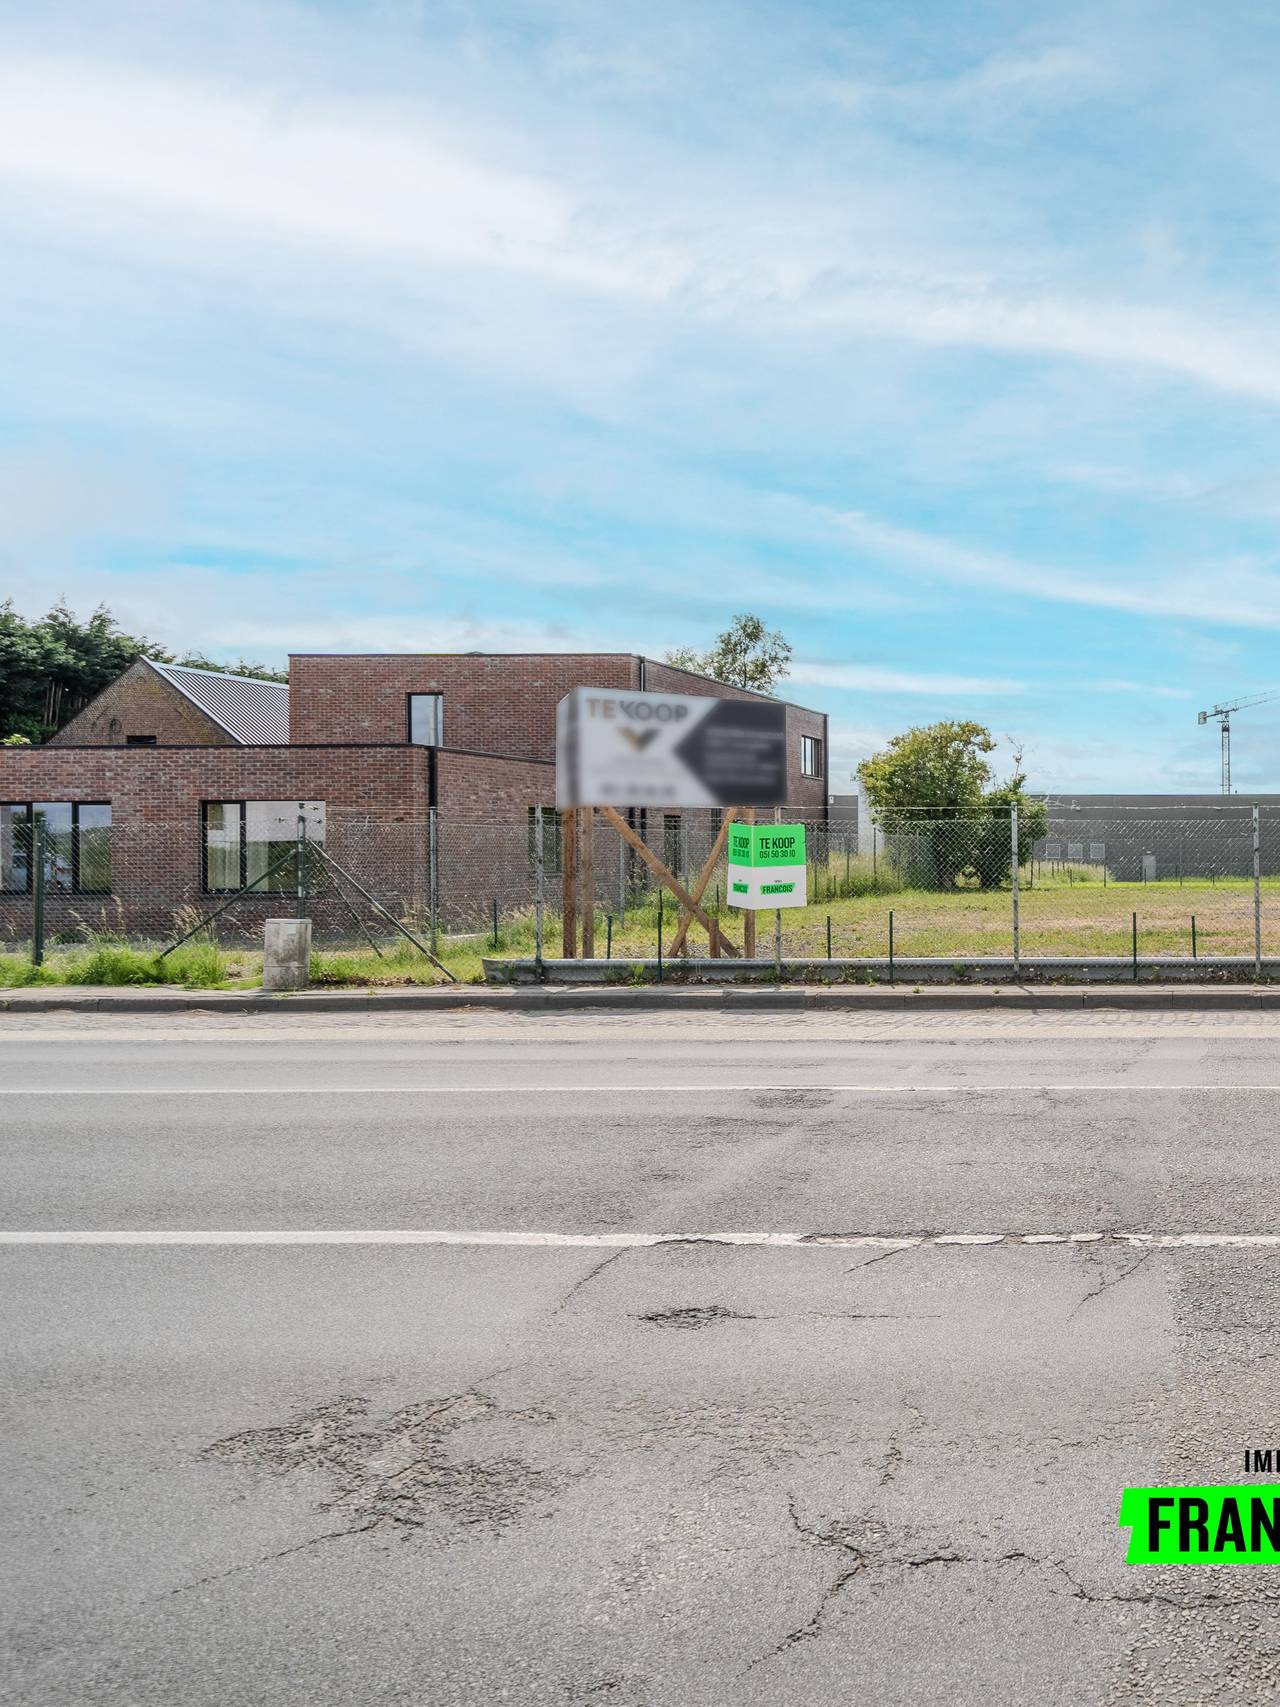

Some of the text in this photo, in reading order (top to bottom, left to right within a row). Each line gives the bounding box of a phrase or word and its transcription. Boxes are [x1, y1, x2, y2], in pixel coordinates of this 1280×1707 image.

[586, 698, 688, 723] TE KOOP
[760, 837, 796, 849] TE KOOP
[759, 850, 770, 859] 051
[771, 850, 779, 858] 50
[780, 849, 788, 858] 30
[762, 884, 793, 895] FRANCOIS
